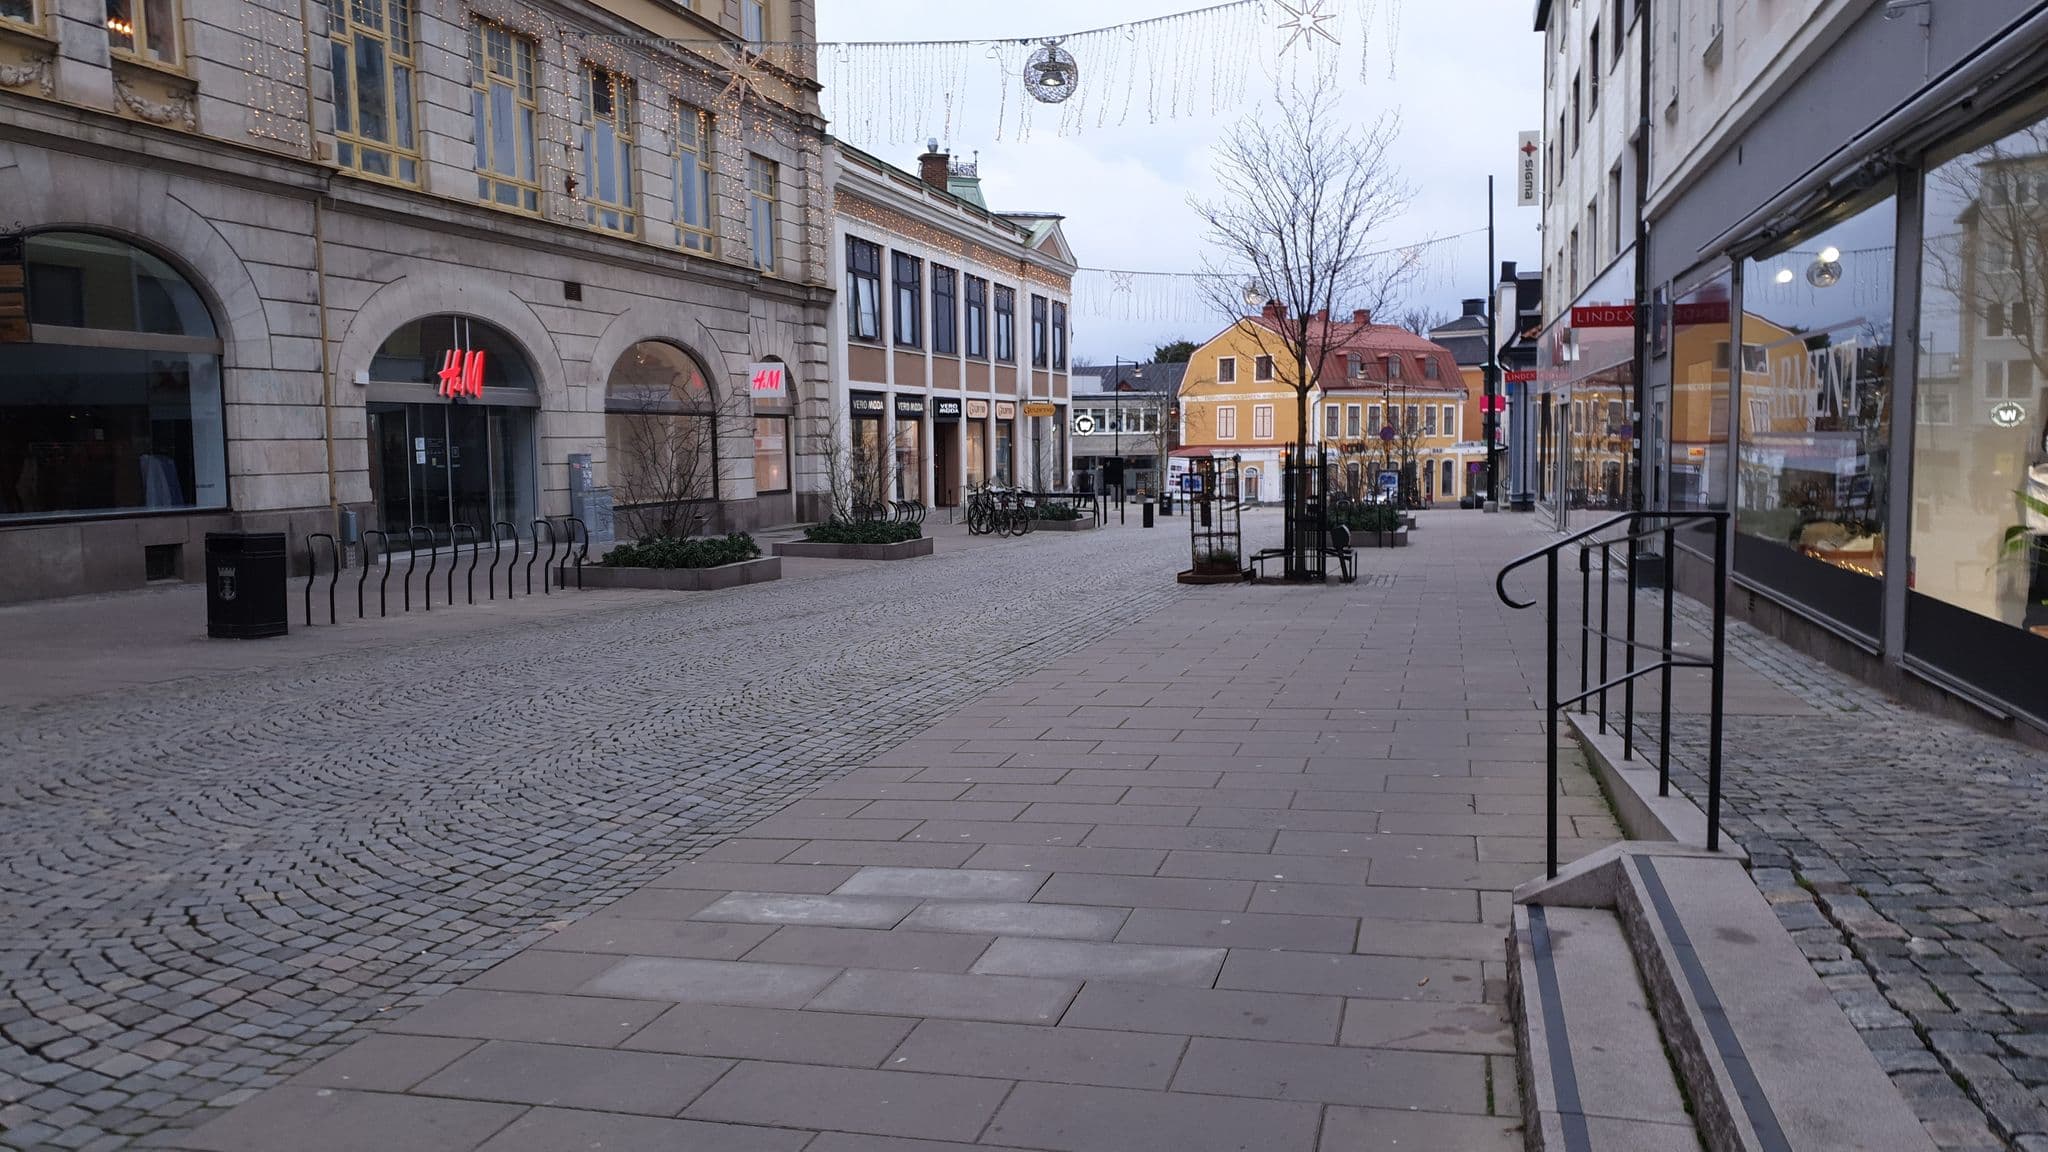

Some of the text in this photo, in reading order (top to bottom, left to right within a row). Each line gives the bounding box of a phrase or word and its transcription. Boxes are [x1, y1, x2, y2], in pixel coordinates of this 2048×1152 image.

[1576, 310, 1635, 324] LINDEX
[437, 349, 484, 399] H&M
[752, 369, 781, 391] H&M
[852, 400, 884, 410] VERO MODA
[897, 402, 910, 411] VERO
